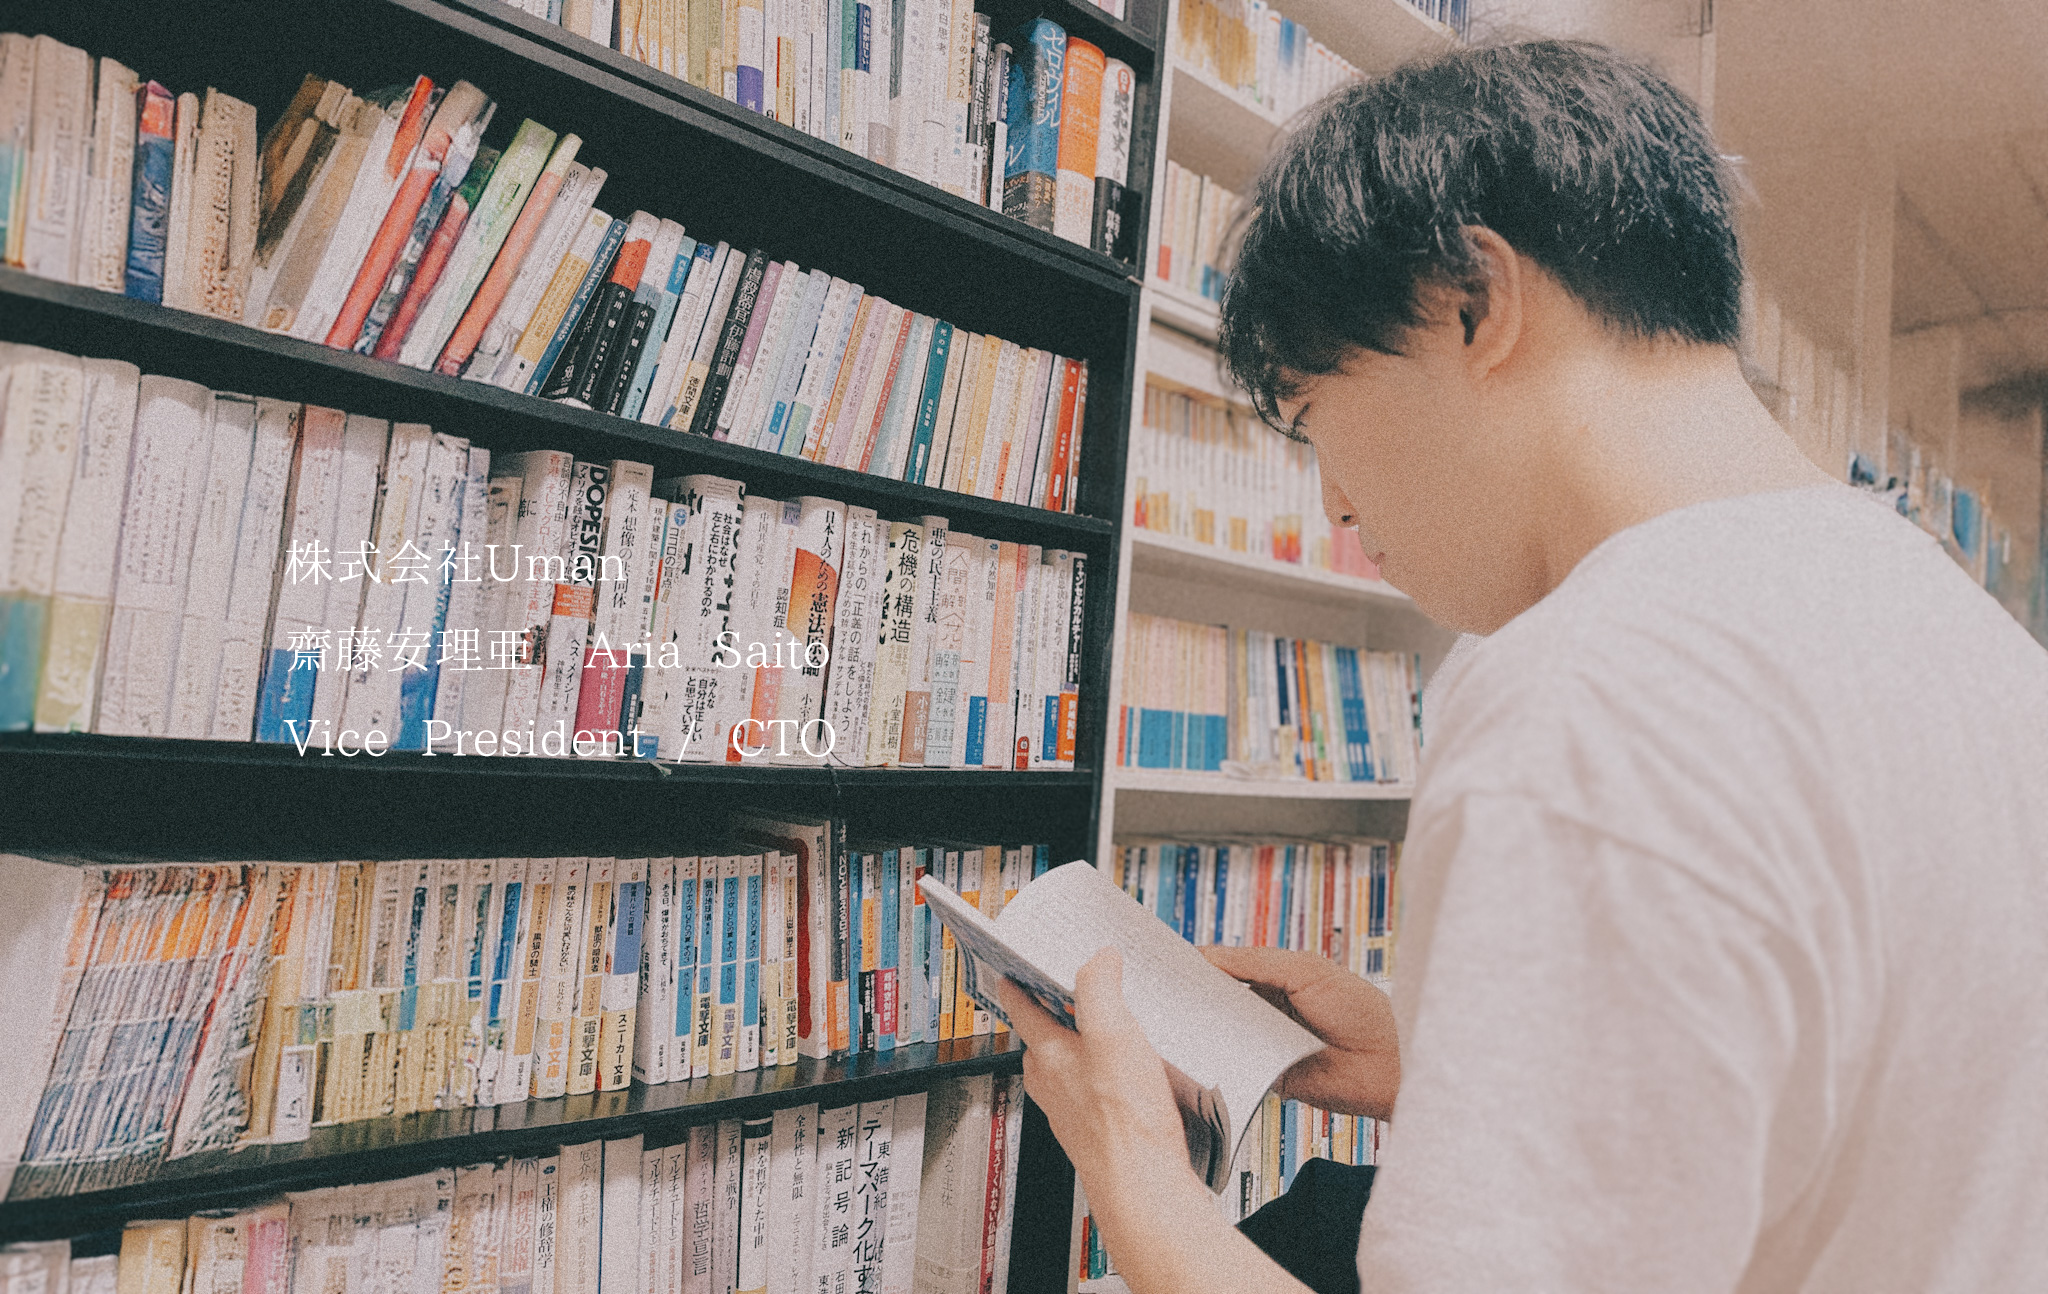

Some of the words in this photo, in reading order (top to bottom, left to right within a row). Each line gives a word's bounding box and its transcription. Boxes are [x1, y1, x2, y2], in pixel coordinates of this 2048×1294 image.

[956, 11, 970, 99] となりのイスラム
[734, 266, 763, 326] 虐殺器官
[714, 324, 747, 382] 伊藤計劃
[573, 466, 608, 587] DOPESICK
[627, 488, 641, 514] 定本
[612, 515, 639, 609] 想像の共同体
[661, 527, 690, 590] ココロの盲点
[700, 510, 724, 619] 左と右にわかれるのか
[802, 509, 836, 677] 日本人のための憲法原論
[889, 528, 920, 645] 危機の構造
[923, 526, 947, 625] 悪の民主主義
[773, 587, 789, 629] 認知症
[1071, 559, 1085, 654] キャンセルカルチャー
[680, 676, 697, 735] と思っている
[692, 679, 710, 742] 自分は正しい
[706, 678, 719, 709] みんな
[886, 694, 903, 751] 小室直樹
[545, 1021, 565, 1079] 電撃文庫
[577, 1020, 598, 1078] 電撃文庫
[611, 1013, 629, 1086] スニーカー文庫
[696, 996, 712, 1049] 電撃文庫
[719, 1008, 737, 1061] 電撃文庫
[785, 998, 798, 1050] 電撃文庫
[576, 1150, 592, 1229] 厄介なる主体
[725, 1128, 740, 1211] 「テロル」と戦争
[791, 1114, 807, 1202] 全体性と無限
[831, 1125, 854, 1250] 新記号論
[873, 1141, 892, 1210] 東浩紀
[941, 1105, 960, 1208] 厄介なる主体
[538, 1183, 556, 1269] 王権の修辞学
[753, 1141, 769, 1250] 神を哲学した中世
[692, 1199, 711, 1277] 哲学宣言
